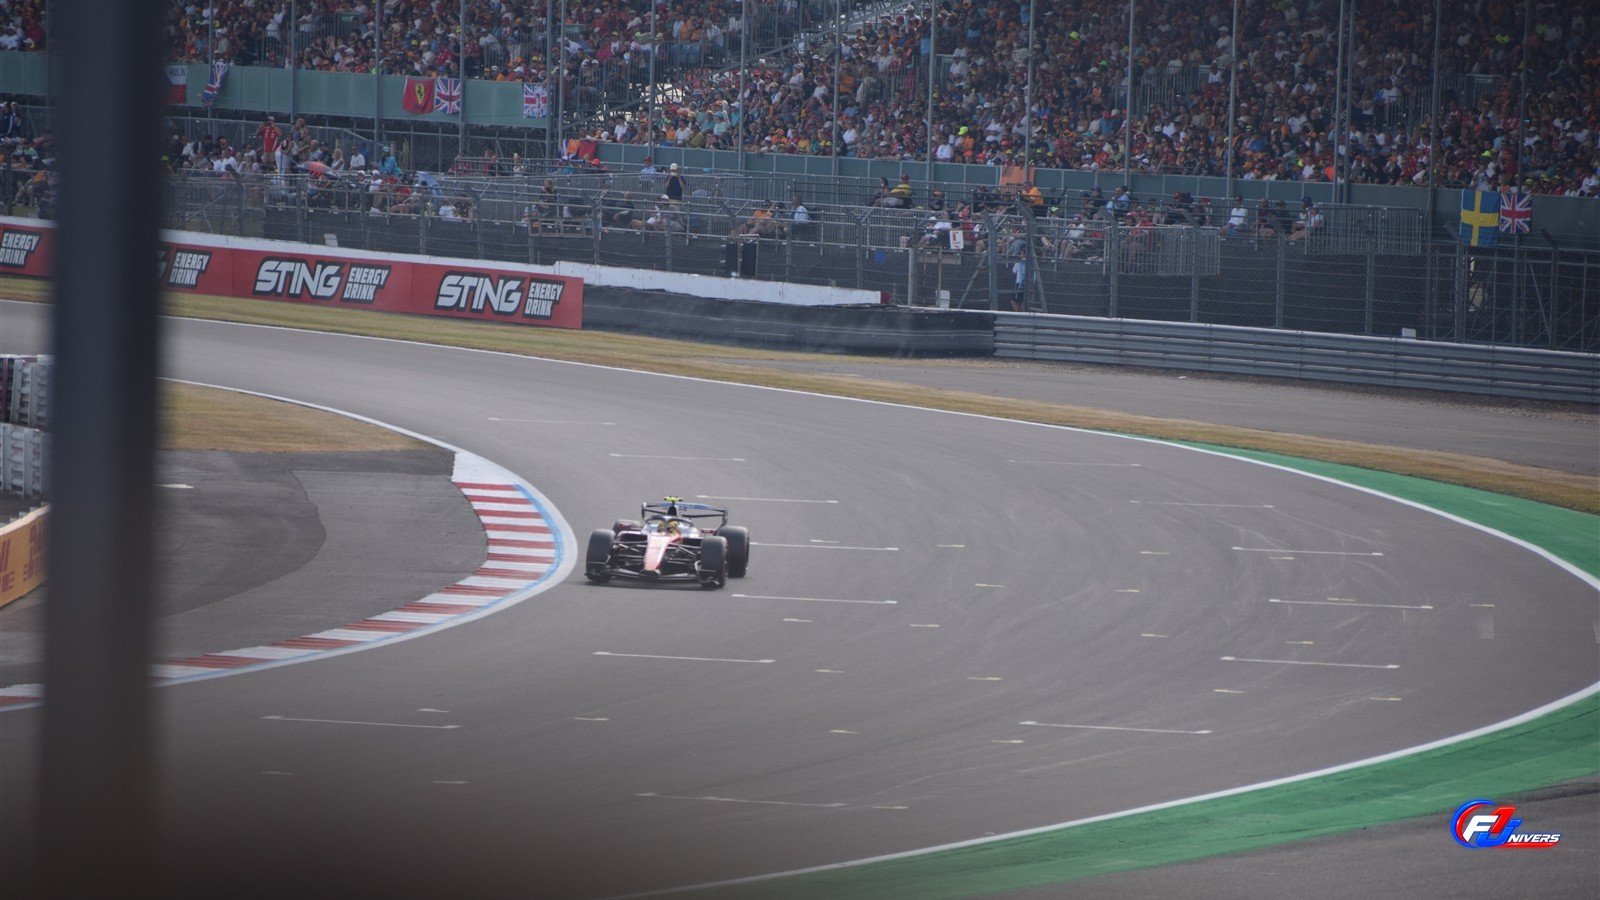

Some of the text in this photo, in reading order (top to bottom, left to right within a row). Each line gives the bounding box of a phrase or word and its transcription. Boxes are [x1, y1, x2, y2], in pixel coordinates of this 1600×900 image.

[2, 232, 39, 250] ENERGY
[173, 252, 209, 270] ENERGY
[169, 268, 198, 285] DRINK
[255, 260, 341, 297] STING
[348, 267, 389, 285] ENERGY
[343, 283, 376, 300] DRINK
[437, 275, 522, 312] STING
[528, 282, 563, 301] ENERGY
[524, 298, 553, 316] DRINK
